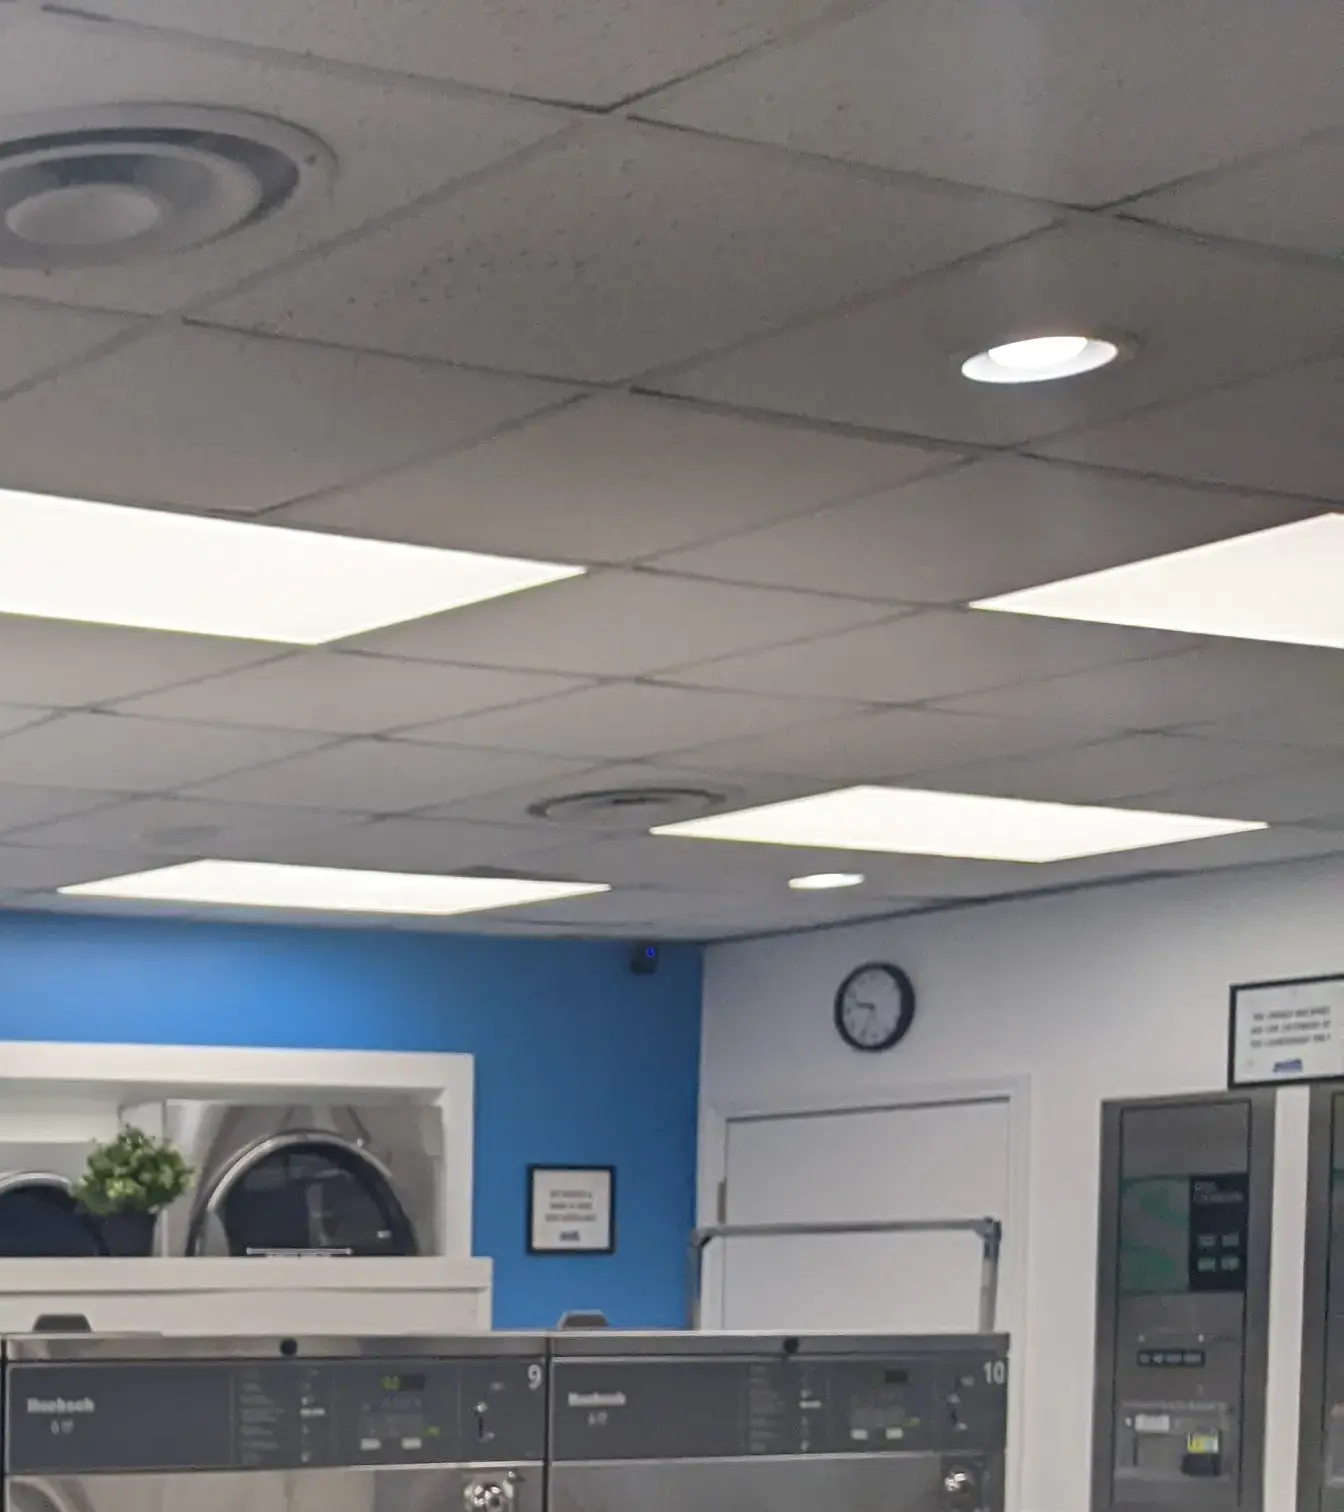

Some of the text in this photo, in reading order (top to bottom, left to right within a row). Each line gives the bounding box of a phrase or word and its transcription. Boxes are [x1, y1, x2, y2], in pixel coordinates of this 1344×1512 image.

[528, 1364, 542, 1390] 9
[982, 1360, 1005, 1384] 10
[27, 1396, 94, 1413] Huebsch
